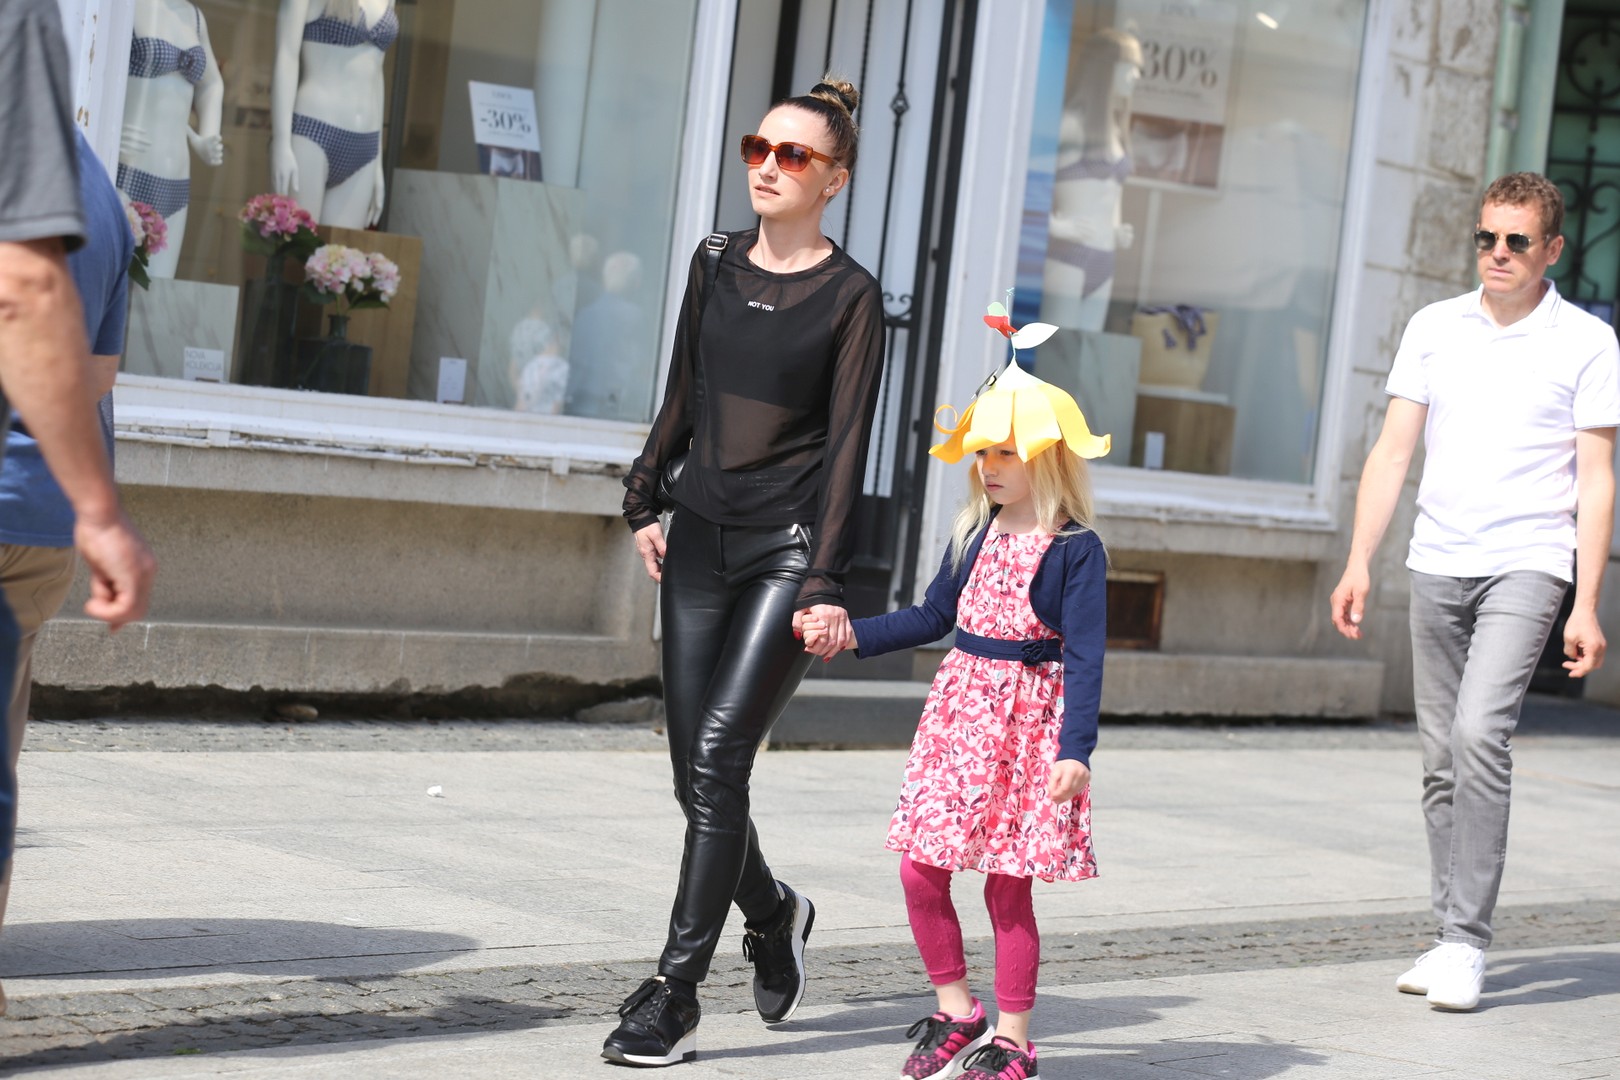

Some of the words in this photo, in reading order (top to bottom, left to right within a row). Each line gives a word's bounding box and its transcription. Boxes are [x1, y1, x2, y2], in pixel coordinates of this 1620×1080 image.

[481, 108, 531, 133] -30%
[748, 300, 761, 308] NOT
[761, 303, 775, 311] YOU
